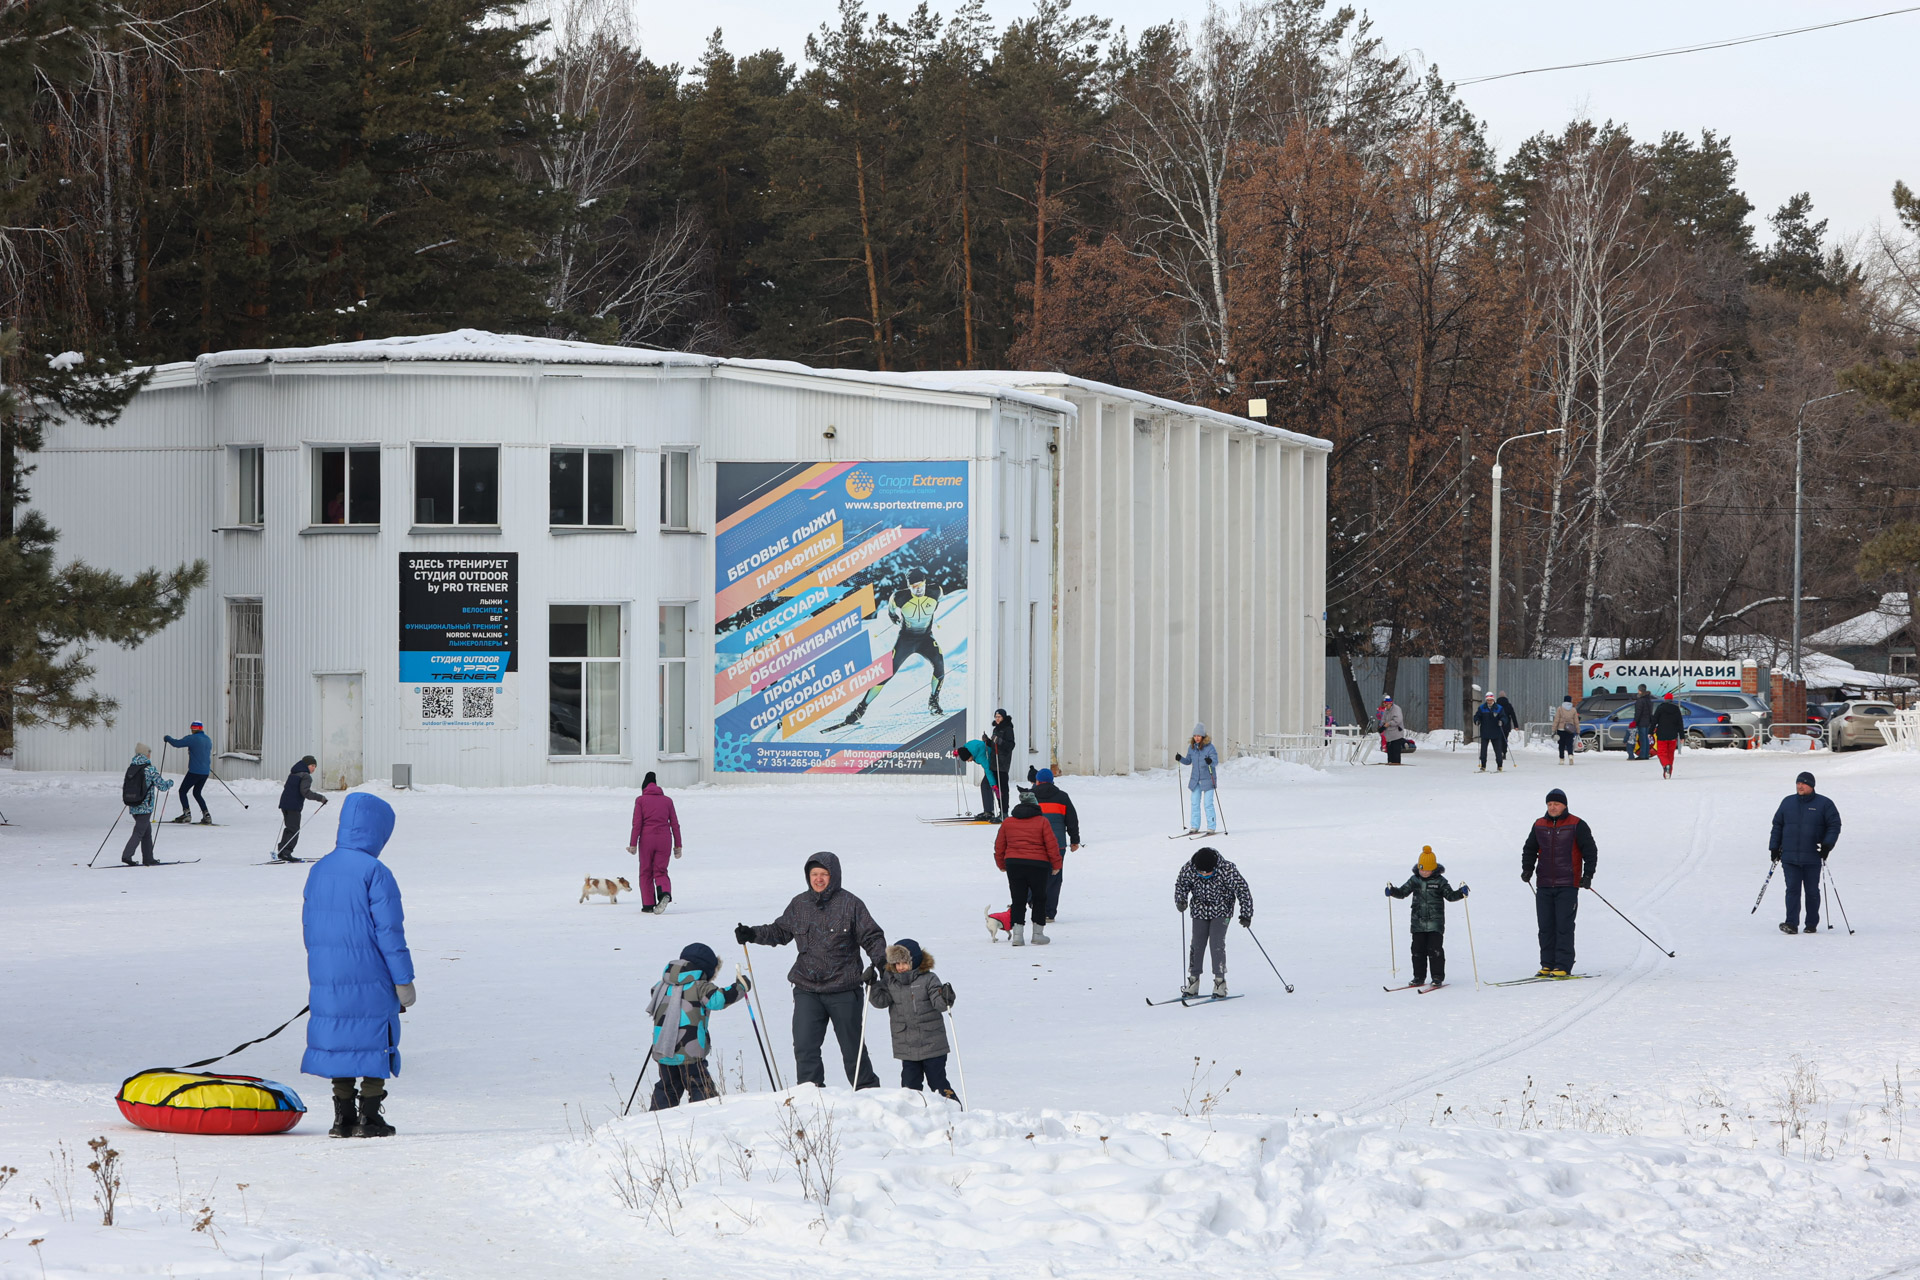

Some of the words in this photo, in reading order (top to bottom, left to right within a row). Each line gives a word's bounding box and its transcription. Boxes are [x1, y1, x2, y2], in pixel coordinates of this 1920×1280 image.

[845, 501, 964, 511] www.sportextreme.pro
[727, 534, 790, 582] БЕГОВЫЕ
[792, 508, 837, 545] ЛЫЖИ
[756, 533, 836, 589] ПАРАФИНЫ
[817, 525, 903, 585] ИНСТРУМЕНТ
[409, 560, 444, 570] ЗДЕСЬ
[447, 560, 508, 568] ТРЕНИРУЕТ
[414, 571, 456, 582] СТУДИЯ
[459, 571, 508, 580] OUTDOOR
[428, 583, 439, 594] by
[443, 583, 463, 591] PRO
[466, 583, 508, 591] TRENER
[745, 588, 830, 645] АКСЕССУАРЫ
[749, 612, 859, 686] ОБСЛУЖИВАНИЕ
[430, 656, 462, 664] СТУДИЯ
[727, 642, 782, 680] РЕМОНТ
[784, 633, 795, 648] И
[1616, 665, 1736, 677] СКАНДИНАВИЯ
[764, 664, 818, 705] ПРОКАТ
[749, 668, 843, 730] СНОУБОРДОВ
[845, 661, 856, 676] И
[789, 690, 847, 727] ГОРНЫХ
[849, 662, 886, 694] ЛЫЖ
[757, 749, 823, 759] Энтузиастов,
[825, 749, 830, 757] 7
[843, 750, 943, 760] Молодогвардейцев,
[757, 759, 768, 767] +7
[771, 759, 836, 767] 351-265-60-05
[843, 760, 855, 768] +7
[857, 760, 923, 769] 351-271-6-777
